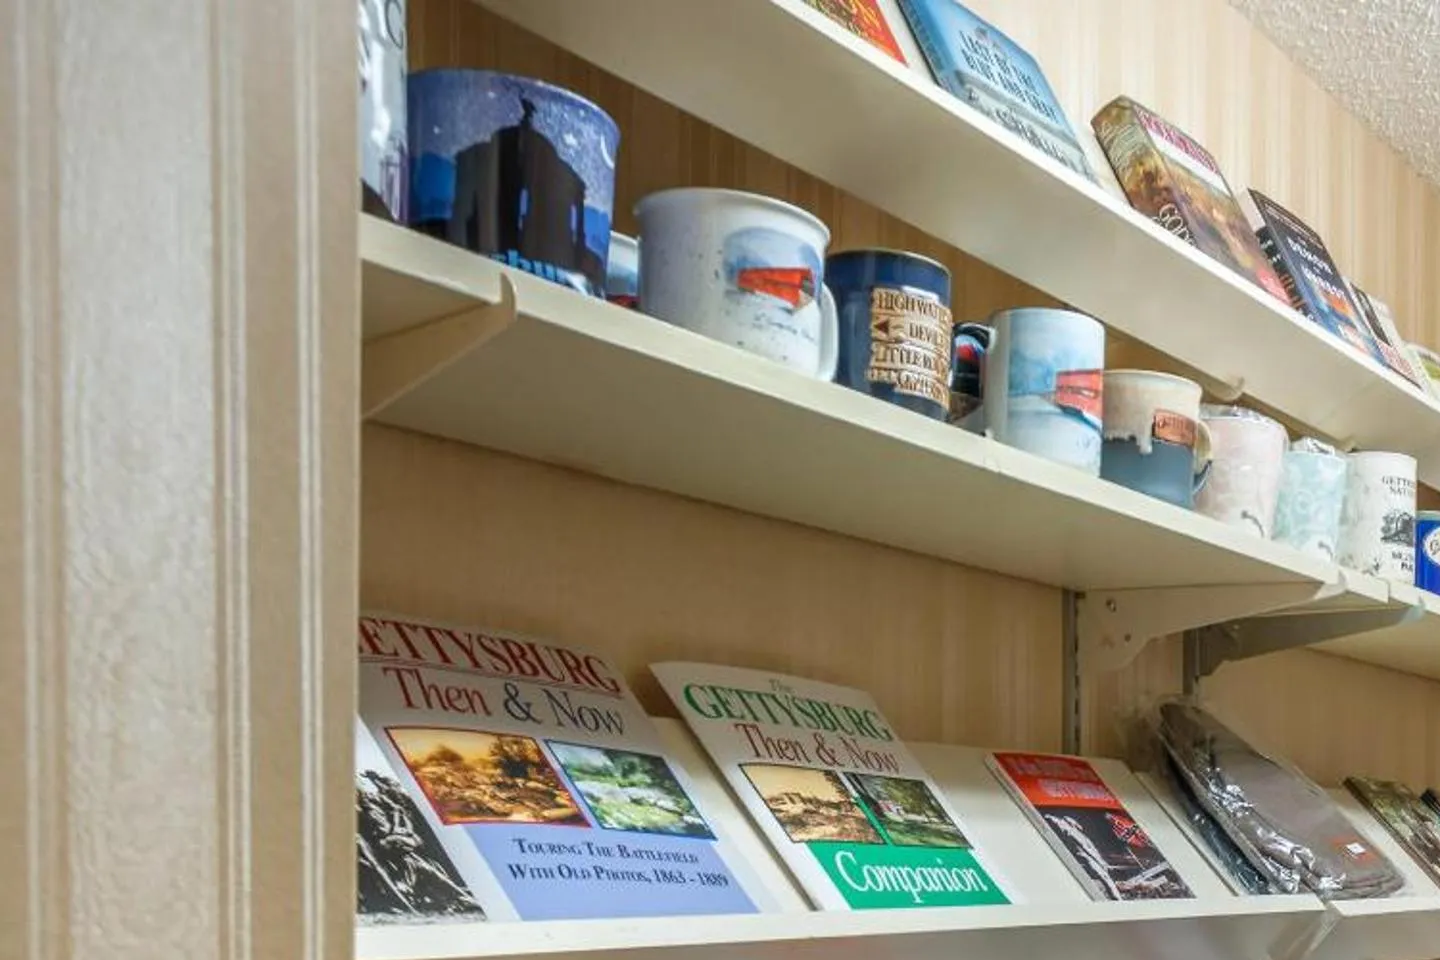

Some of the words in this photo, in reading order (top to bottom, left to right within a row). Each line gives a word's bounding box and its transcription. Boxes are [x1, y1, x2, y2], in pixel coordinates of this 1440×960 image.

[359, 617, 622, 694] ETTYSBURG
[383, 667, 492, 716] Then
[504, 681, 543, 724] &
[542, 687, 625, 736] Now
[683, 683, 894, 742] GETTYSBURG
[734, 723, 811, 764] Then
[812, 731, 845, 768] &
[840, 736, 900, 774] Now
[834, 851, 987, 902] Companion
